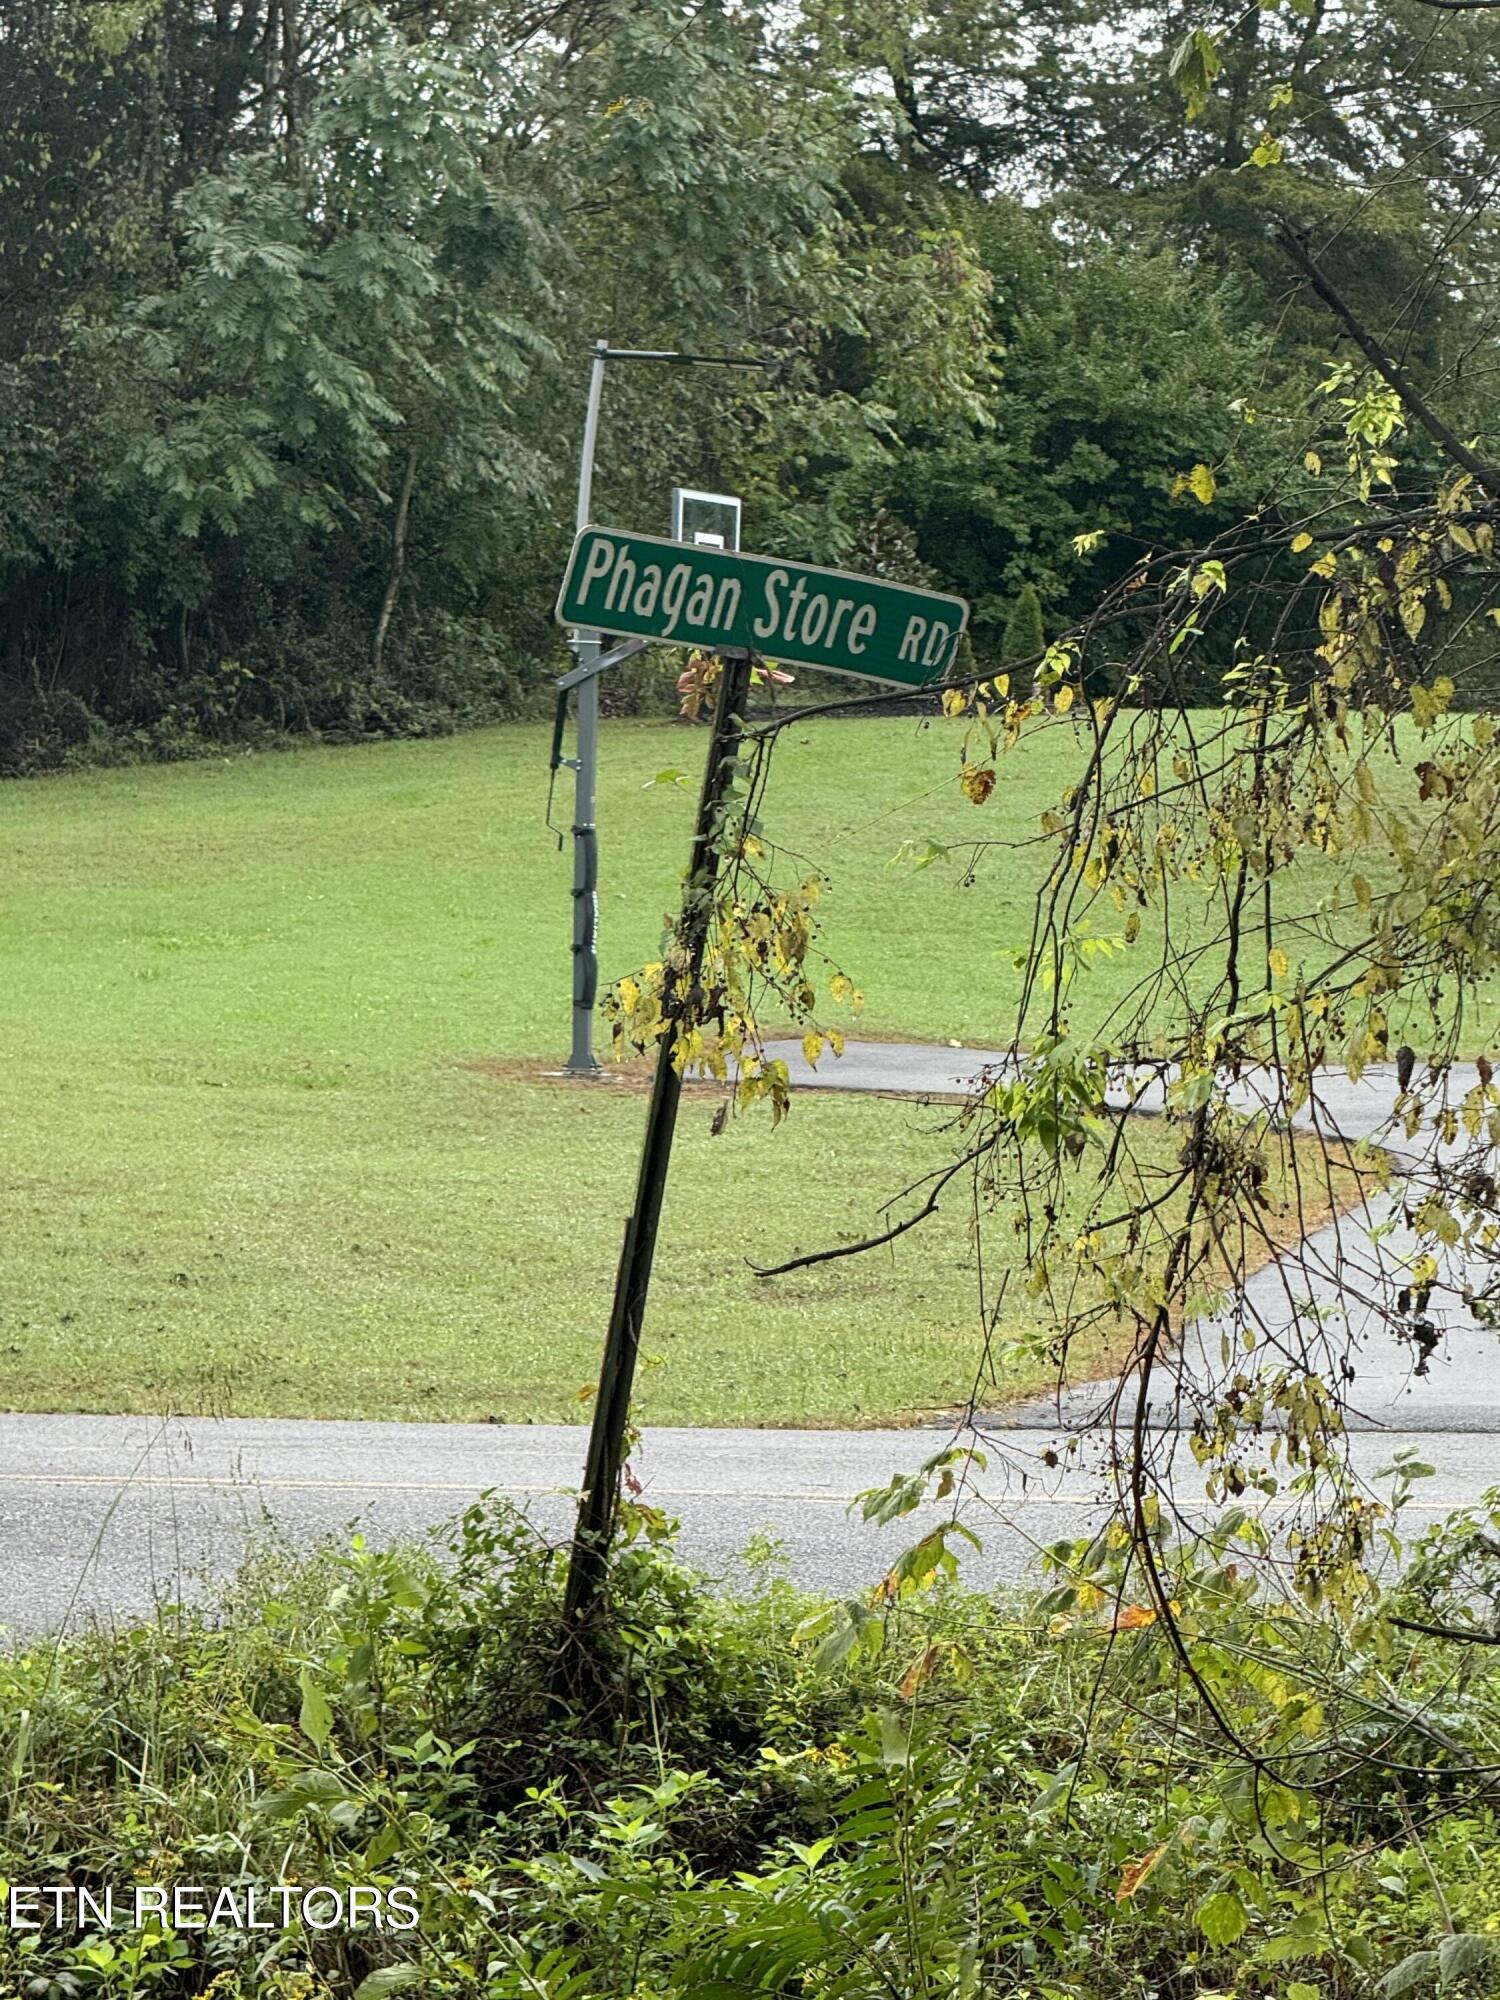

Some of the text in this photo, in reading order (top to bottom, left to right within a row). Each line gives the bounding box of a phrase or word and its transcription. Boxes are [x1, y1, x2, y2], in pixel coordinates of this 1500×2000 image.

[576, 538, 950, 667] Phagan Store RD
